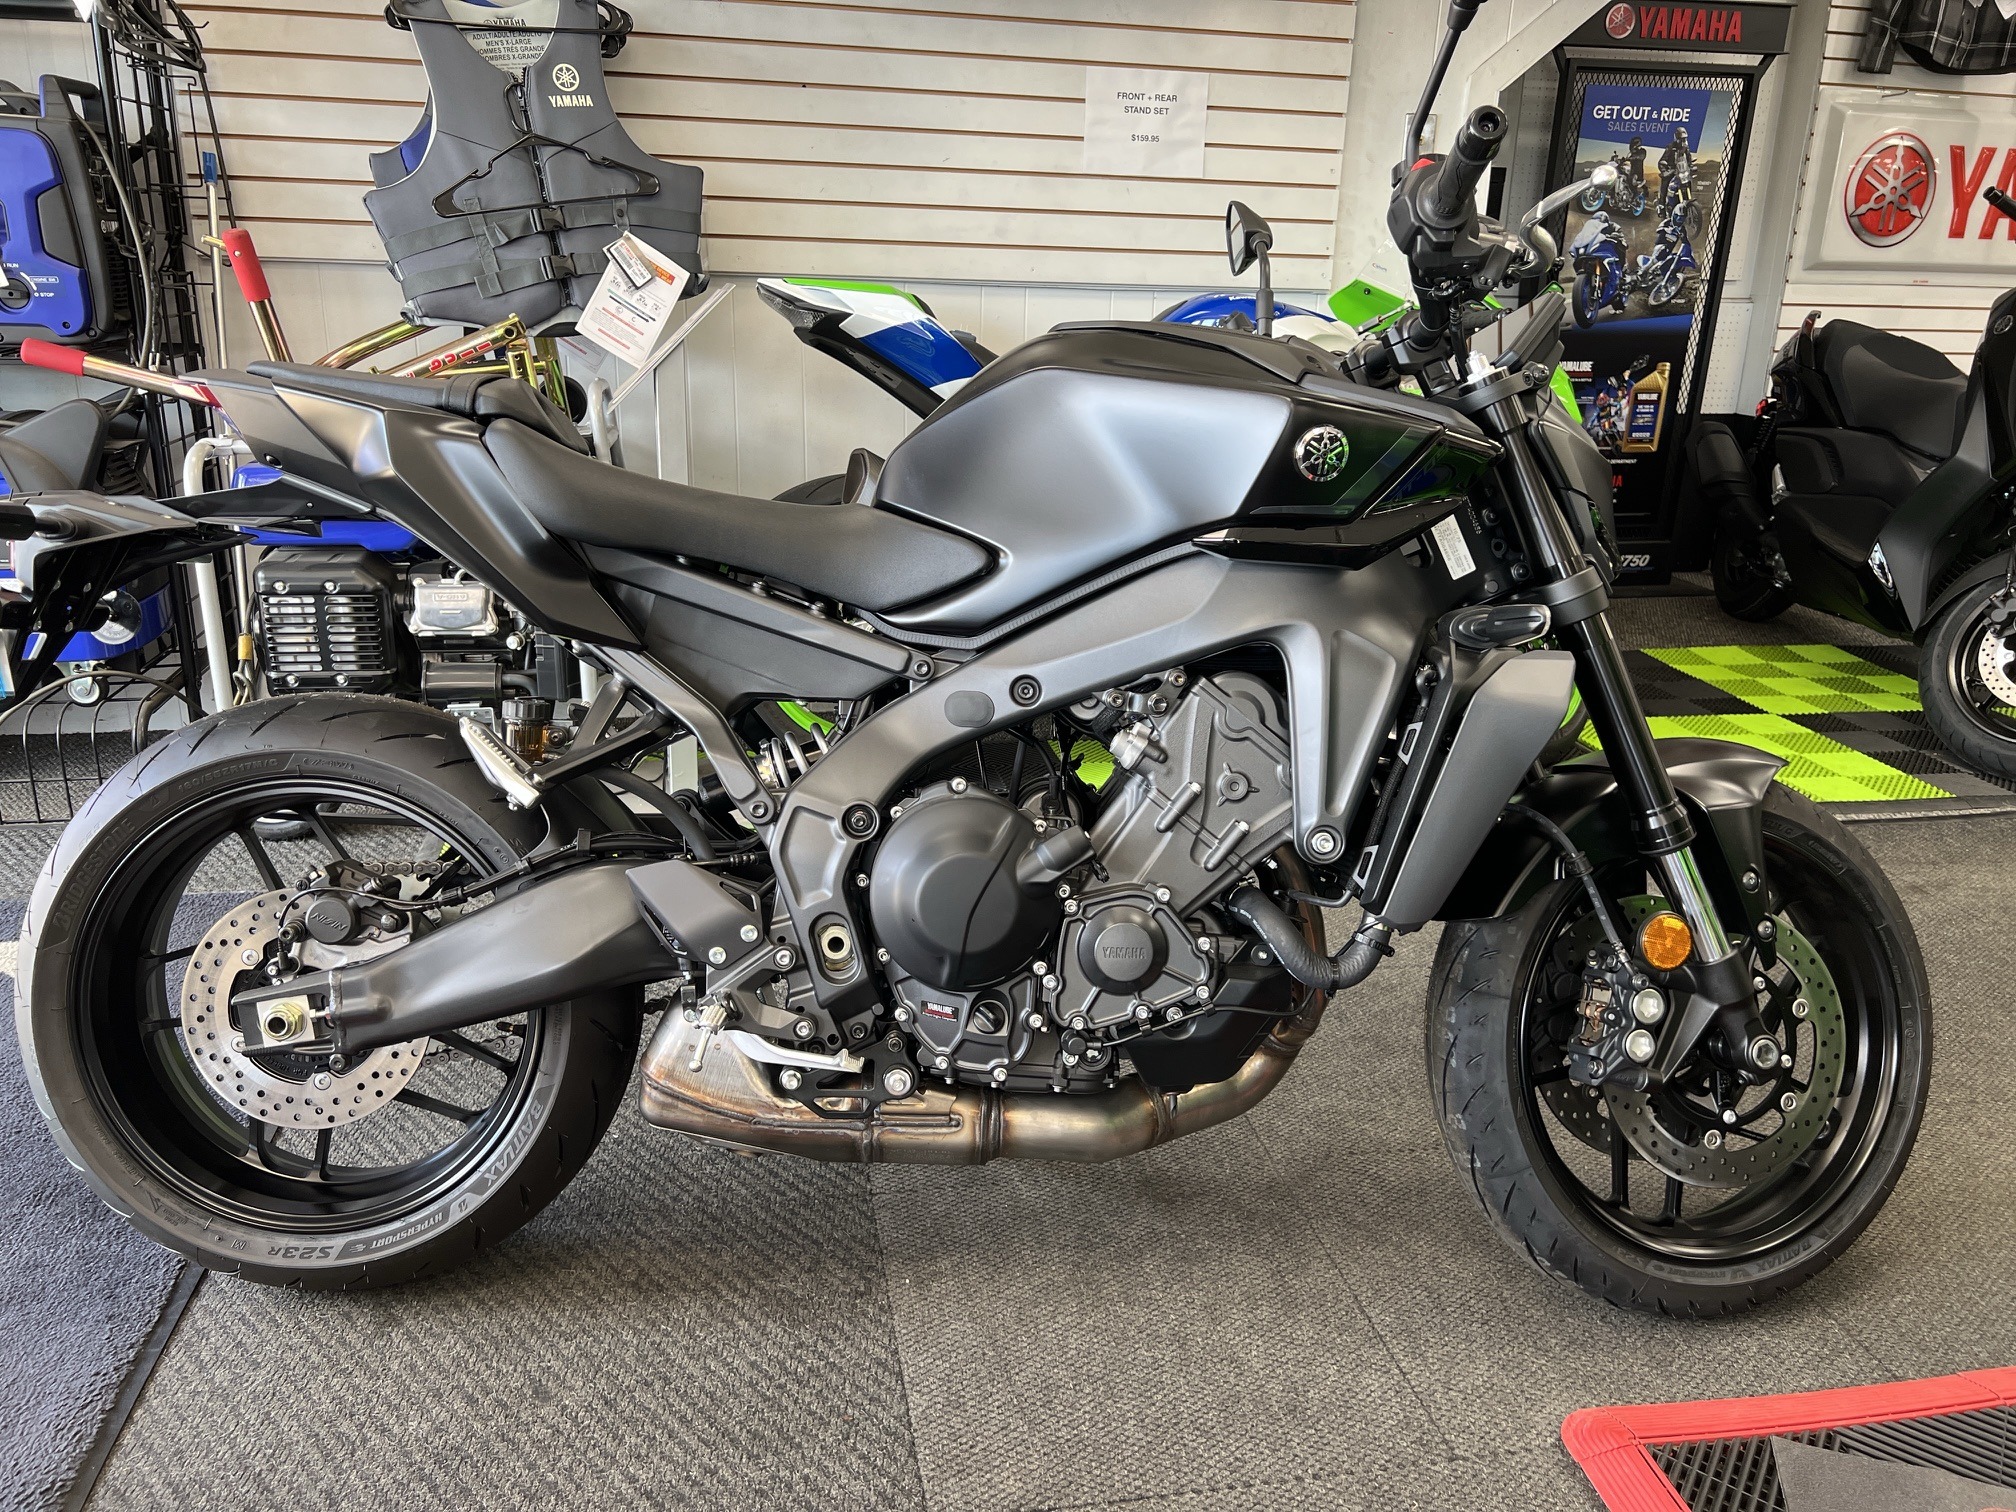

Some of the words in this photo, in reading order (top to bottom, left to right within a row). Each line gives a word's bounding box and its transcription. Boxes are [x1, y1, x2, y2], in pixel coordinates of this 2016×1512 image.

[1639, 6, 1742, 42] YAMAHA
[548, 94, 594, 107] YAMAHA
[1117, 92, 1146, 101] FRONT
[1155, 94, 1178, 102] REAR
[1124, 106, 1152, 115] STAND
[1153, 107, 1170, 115] SET
[1593, 105, 1620, 119] GET
[1621, 106, 1651, 120] OUT
[1651, 110, 1659, 119] &
[1660, 107, 1691, 122] RIDE
[1607, 121, 1637, 132] SALES
[1639, 122, 1671, 133] EVENT
[1131, 134, 1160, 142] $159.95
[53, 816, 136, 928] BRIDGESTONE
[1102, 946, 1146, 959] YAMAHA
[484, 1096, 544, 1187] BATTLAX
[370, 1211, 443, 1249] HYPERSPORT
[268, 1245, 335, 1260] S23R
